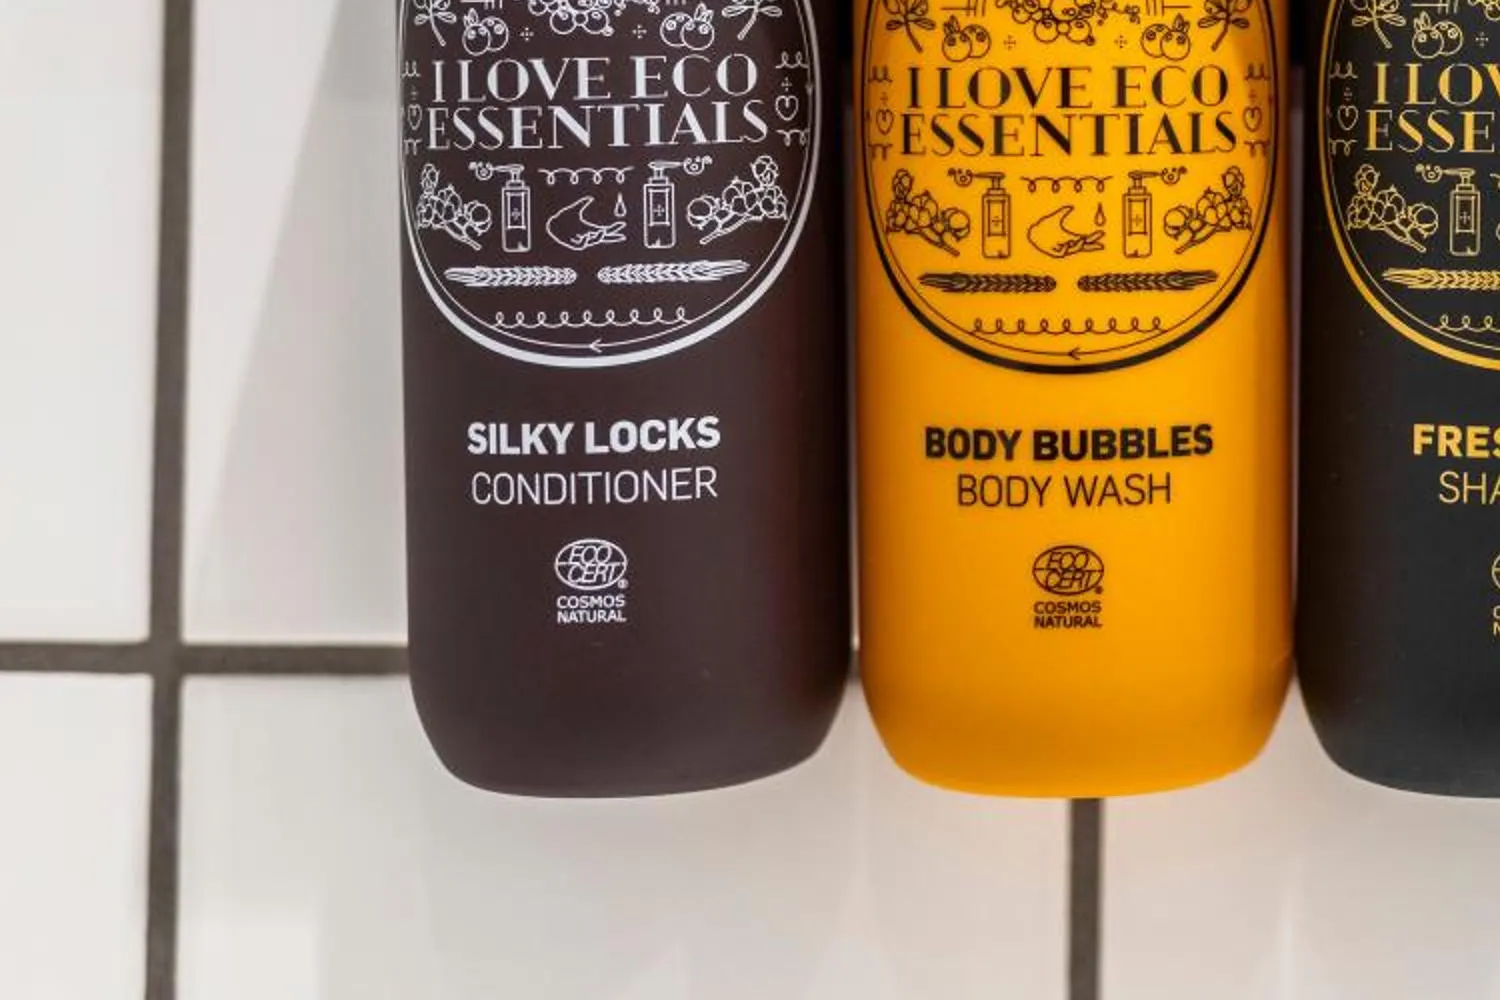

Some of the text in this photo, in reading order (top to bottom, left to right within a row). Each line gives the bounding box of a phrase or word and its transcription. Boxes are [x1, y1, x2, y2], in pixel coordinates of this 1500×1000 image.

[432, 53, 758, 102] I LOVE ECO
[907, 66, 1229, 109] I LOVE ECO
[1374, 63, 1390, 106] I
[426, 99, 769, 151] ESSENTIALS
[900, 111, 1237, 157] ESSENTIALS
[467, 415, 721, 455] SILKY LOCKS
[925, 423, 1214, 461] BODY BUBBLES
[471, 465, 718, 505] CONDITIONER
[957, 472, 1172, 508] BODY WASH
[569, 545, 612, 564] ECO
[1048, 551, 1089, 570] ECO
[567, 564, 619, 583] CERT
[1045, 570, 1096, 589] CERT
[557, 594, 626, 609] COSMOS
[557, 610, 627, 624] NATURAL
[1033, 601, 1102, 614] COSMOS
[1034, 615, 1103, 629] NATURAL
